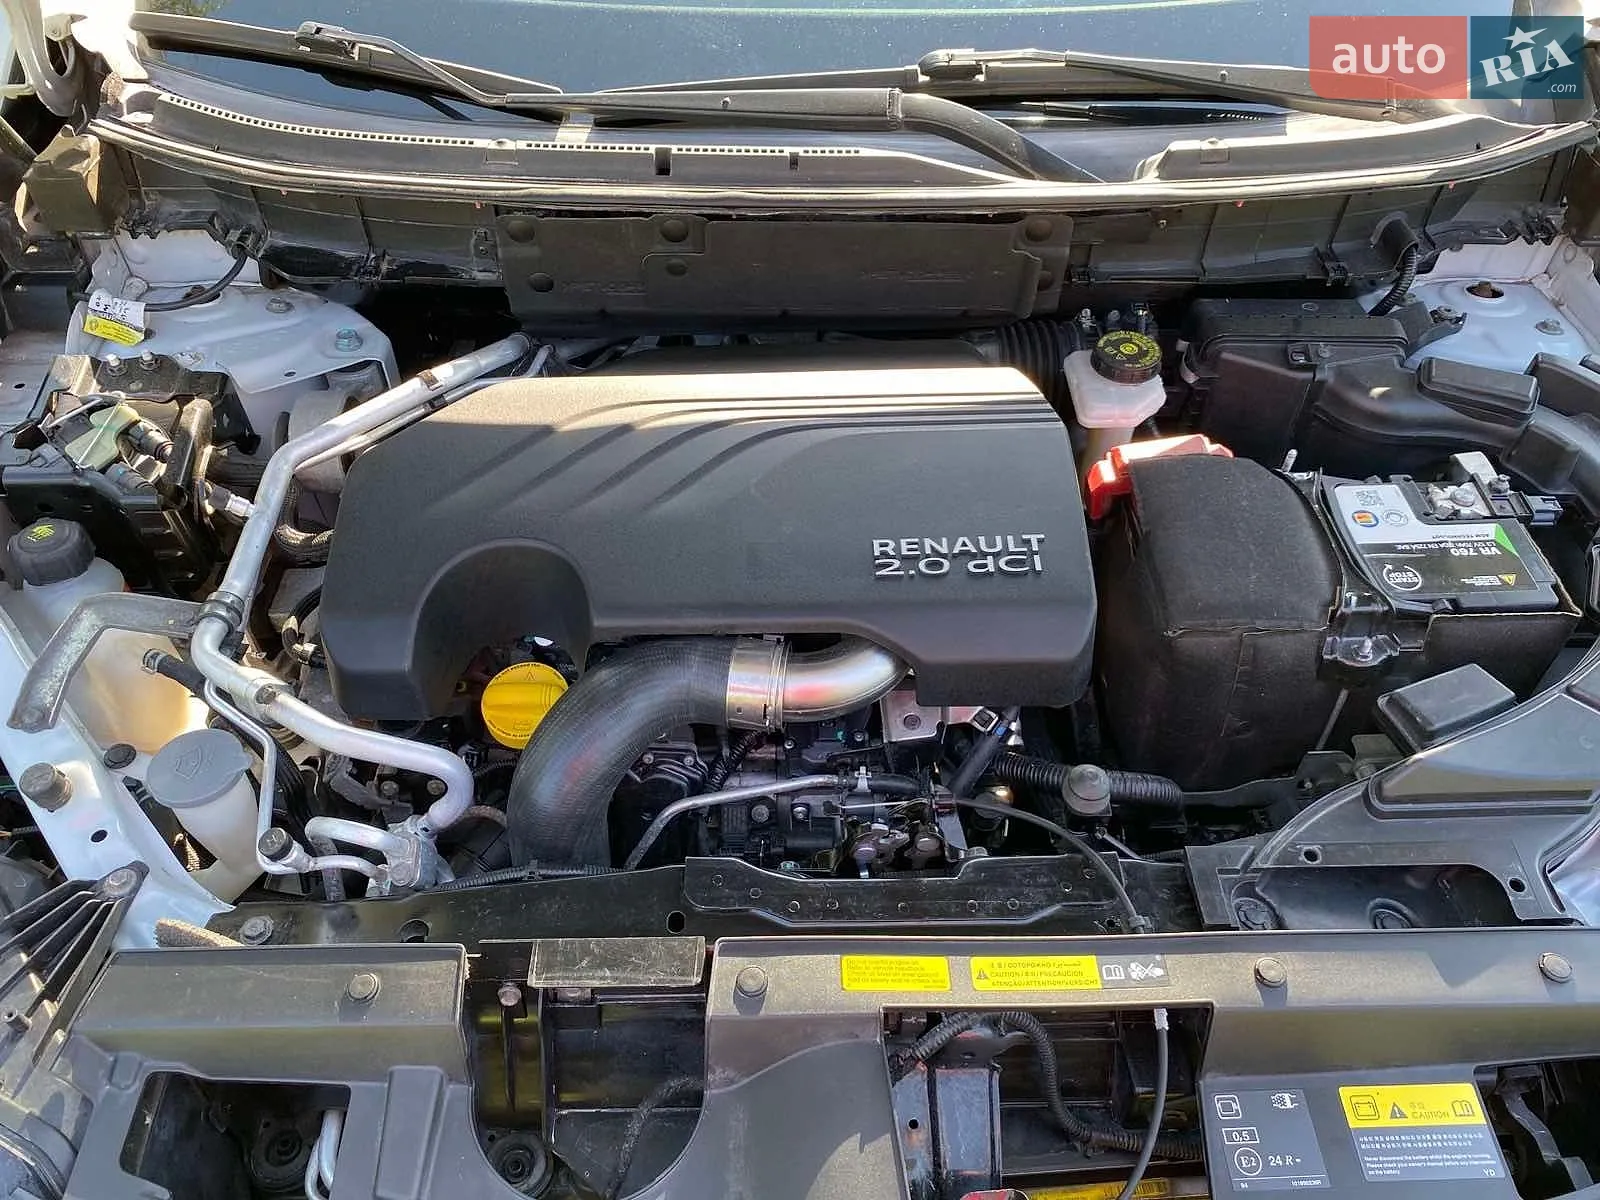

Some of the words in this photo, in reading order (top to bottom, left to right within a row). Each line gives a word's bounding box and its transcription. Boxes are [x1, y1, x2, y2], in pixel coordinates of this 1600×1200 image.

[872, 533, 1046, 556] RENAULT
[1450, 547, 1477, 557] 760
[874, 557, 952, 576] 2.0
[1388, 571, 1415, 579] STOP
[1389, 576, 1419, 584] START
[1411, 1111, 1450, 1121] CAUTION
[1232, 1131, 1250, 1142] 0,5
[1240, 1155, 1257, 1168] E2
[1268, 1155, 1283, 1166] 24
